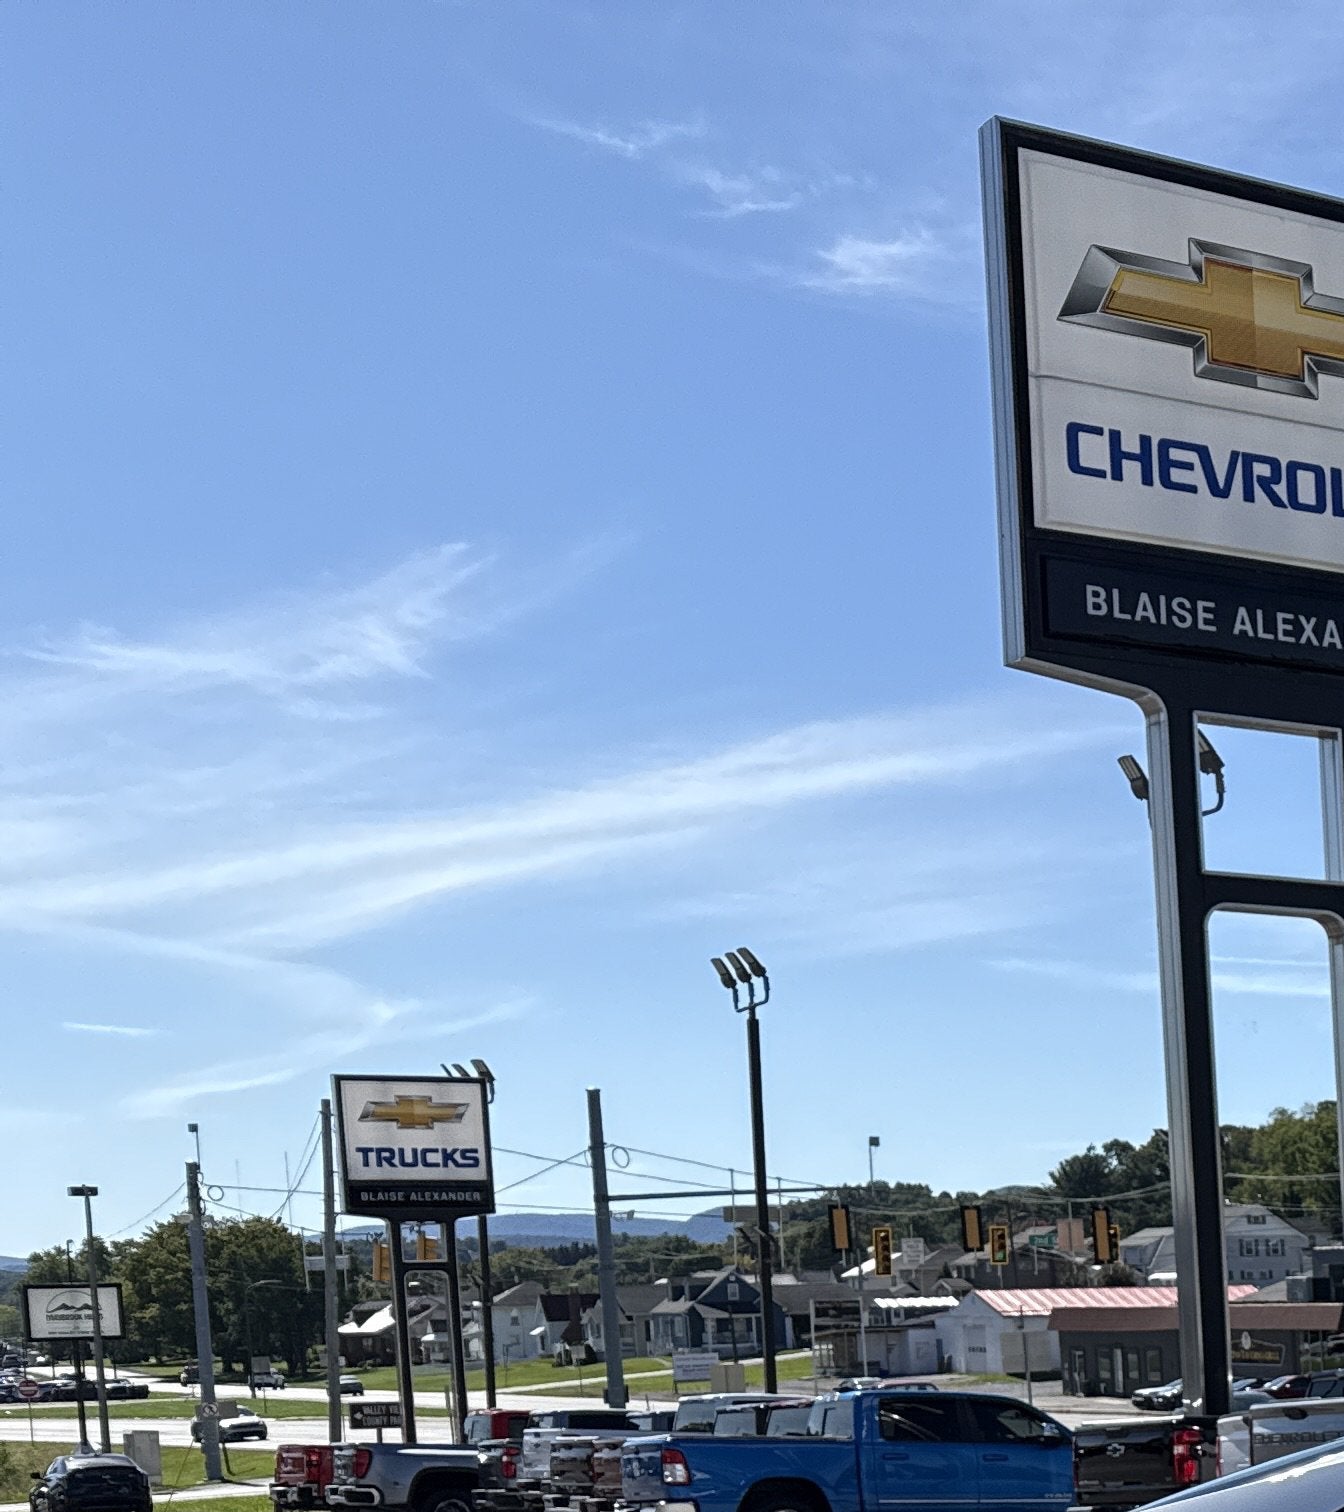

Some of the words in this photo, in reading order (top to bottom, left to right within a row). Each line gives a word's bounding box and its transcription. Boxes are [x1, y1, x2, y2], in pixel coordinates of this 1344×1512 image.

[1085, 584, 1217, 632] BLAISE
[355, 1147, 480, 1168] TRUCKS
[360, 1191, 406, 1201] BLAISE
[409, 1191, 481, 1201] ALEXANDER
